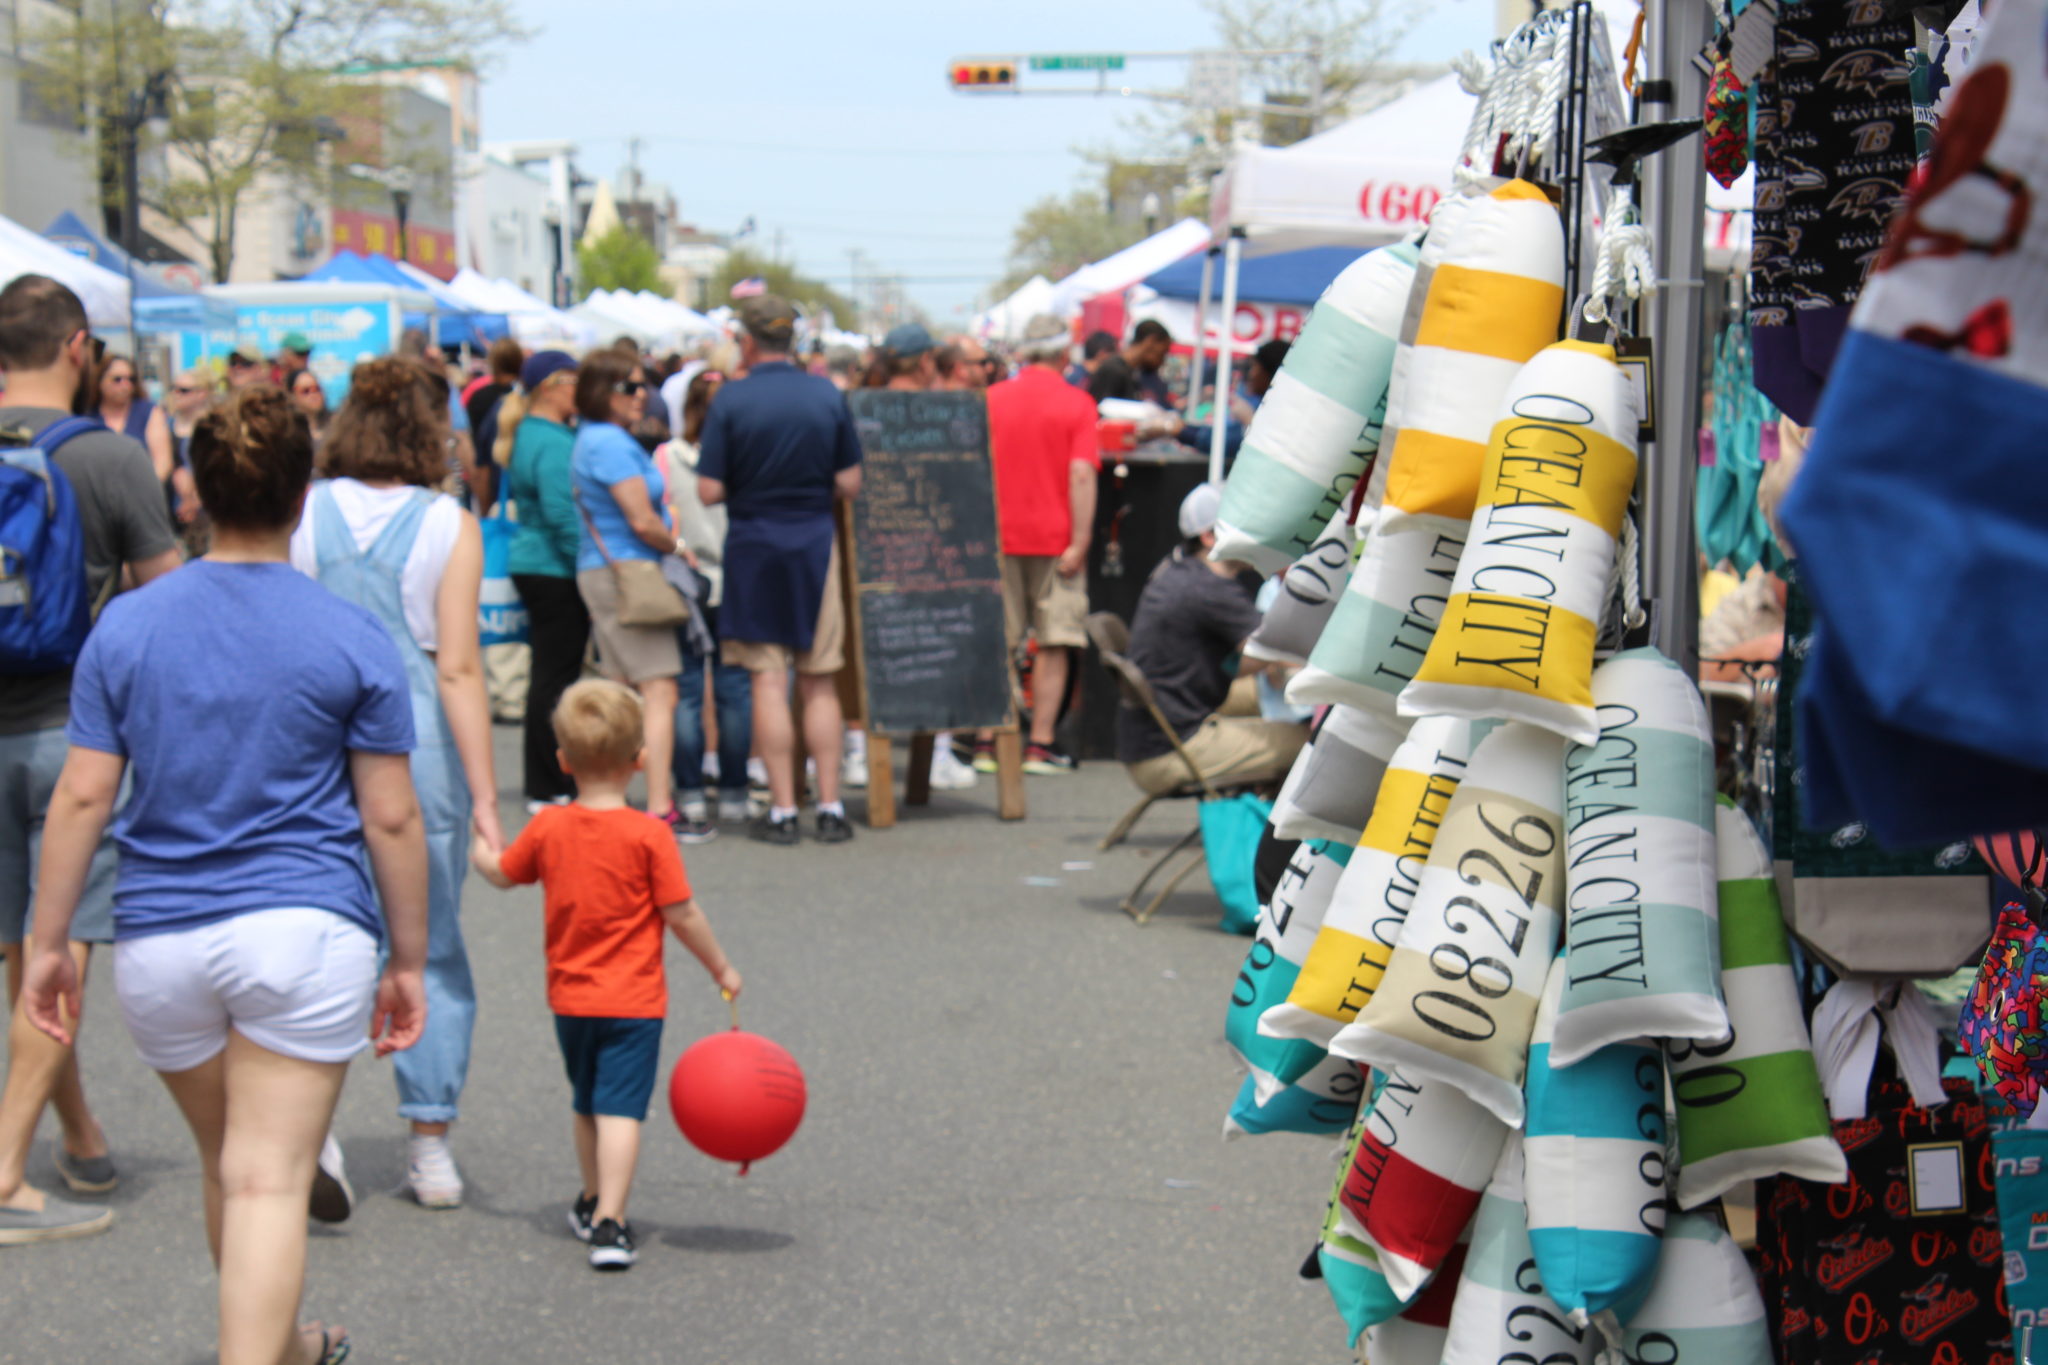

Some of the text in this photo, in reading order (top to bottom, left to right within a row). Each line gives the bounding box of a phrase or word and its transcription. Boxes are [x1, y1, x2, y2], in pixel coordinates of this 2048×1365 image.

[1827, 30, 1909, 49] RAVENS
[1831, 104, 1913, 123] RAVENS
[1835, 156, 1914, 177] RAVENS
[1455, 394, 1594, 689] OCEAN CITY
[1412, 803, 1555, 1041] 08226
[1569, 877, 1648, 990] CITY
[1817, 1237, 1895, 1290] Orioles
[1901, 1288, 1979, 1343] Orioles
